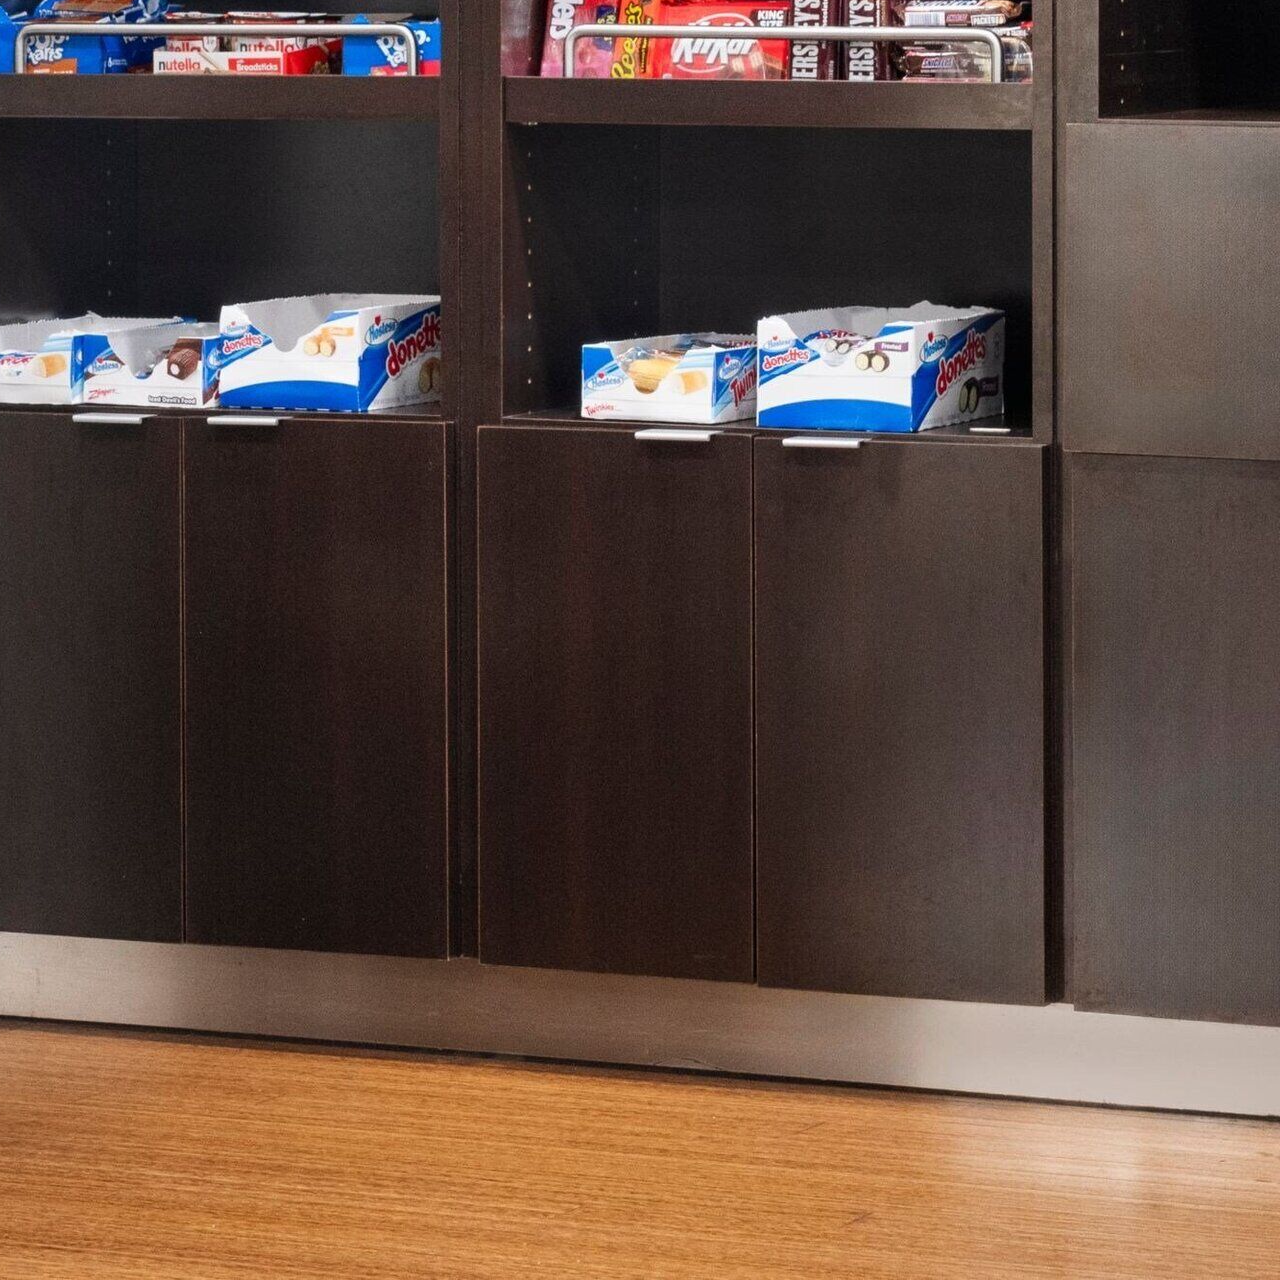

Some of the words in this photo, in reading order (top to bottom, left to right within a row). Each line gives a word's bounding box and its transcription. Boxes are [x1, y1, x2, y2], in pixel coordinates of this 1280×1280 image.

[757, 9, 785, 21] KING
[158, 58, 201, 71] nutella
[236, 60, 279, 72] Breadsticks
[223, 332, 262, 354] donettes
[762, 349, 811, 372] donettes
[935, 329, 987, 397] donettes
[587, 375, 623, 390] Hostess
[585, 403, 615, 417] Twinkies
